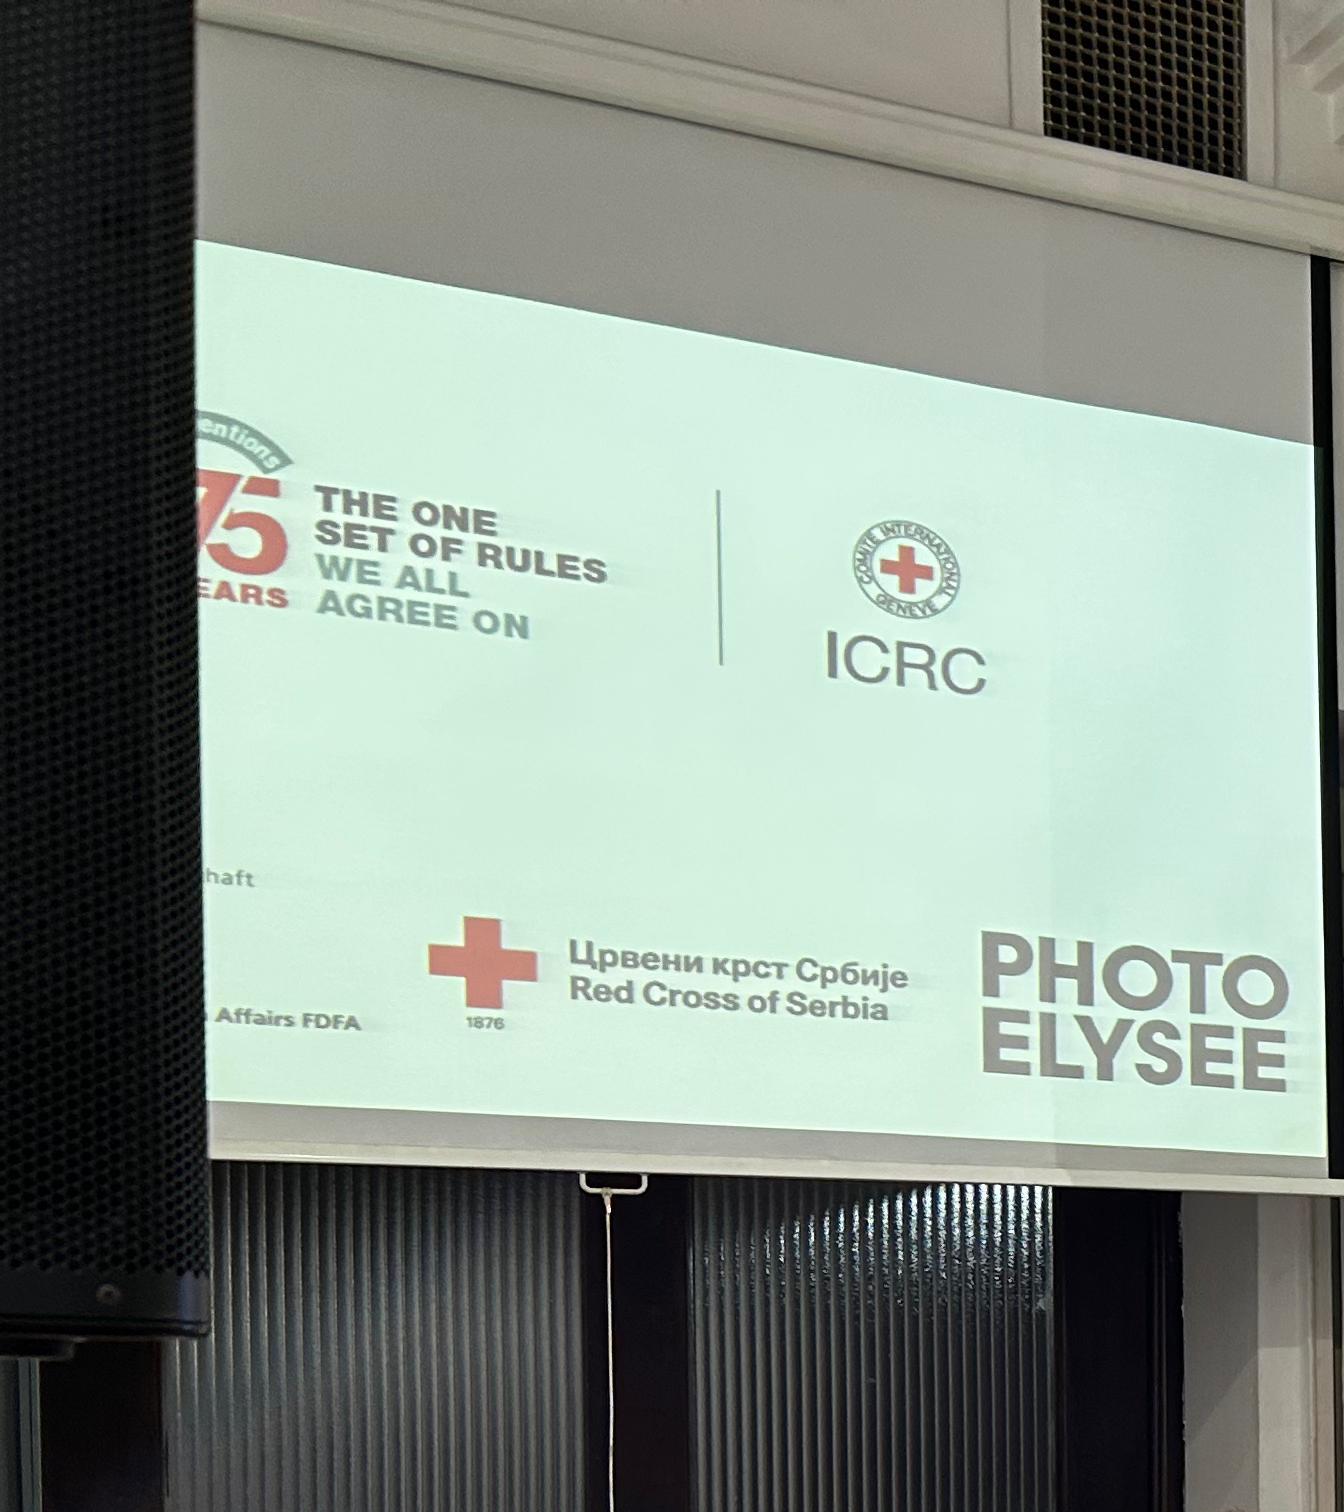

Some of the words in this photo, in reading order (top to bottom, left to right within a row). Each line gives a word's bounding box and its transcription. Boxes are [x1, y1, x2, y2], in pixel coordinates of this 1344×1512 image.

[199, 416, 280, 470] entions
[314, 484, 398, 521] THE
[411, 500, 498, 537] ONE
[314, 519, 396, 553] SET
[409, 532, 464, 562] OF
[477, 541, 607, 584] RULES
[314, 553, 382, 586] WE
[395, 565, 470, 598] ALL
[197, 577, 289, 608] EARS
[316, 589, 459, 630] AGREE
[472, 610, 530, 640] ON
[827, 630, 987, 695] ICRC
[569, 938, 704, 973] Црвени
[712, 954, 789, 982] крст
[795, 957, 909, 993] Србије
[981, 929, 1289, 1021] PHOTO
[214, 1007, 296, 1027] Affairs
[302, 1013, 362, 1030] FDFA
[466, 1016, 505, 1030] 1876
[569, 975, 634, 1004] Red
[642, 980, 740, 1011] Cross
[747, 990, 780, 1014] of
[785, 990, 889, 1021] Serbia
[982, 1006, 1286, 1093] ELYSEE
